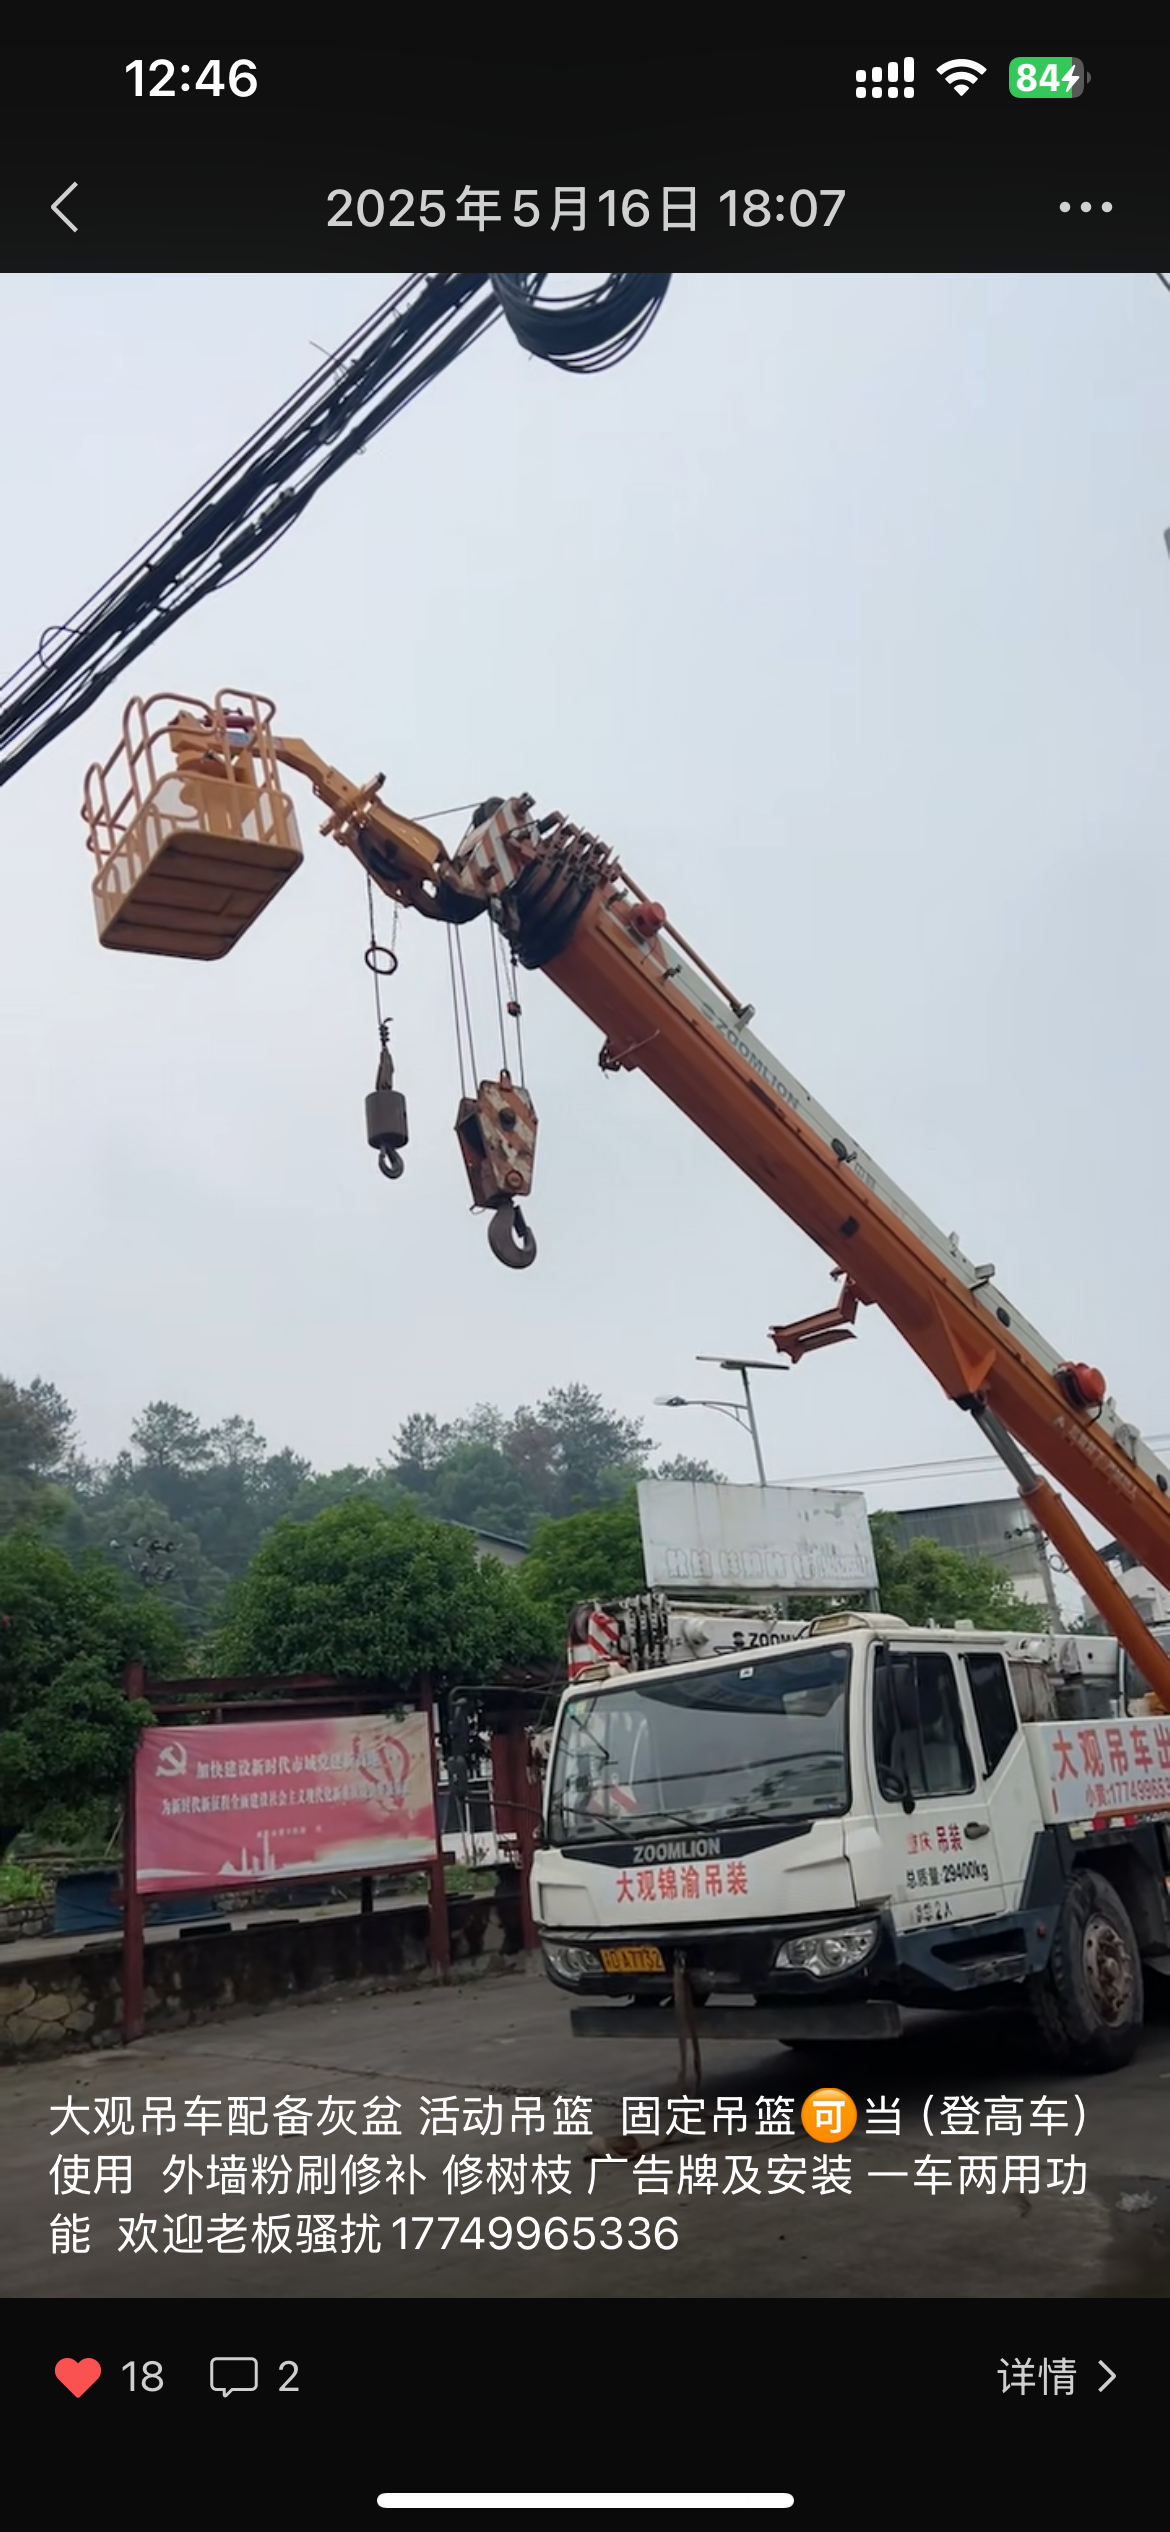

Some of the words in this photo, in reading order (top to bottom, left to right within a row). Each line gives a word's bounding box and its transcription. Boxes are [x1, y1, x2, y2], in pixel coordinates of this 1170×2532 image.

[633, 1837, 721, 1864] ZOOMLION
[936, 1823, 963, 1853] 吊装
[616, 1862, 748, 1903] 大观锦渝吊装
